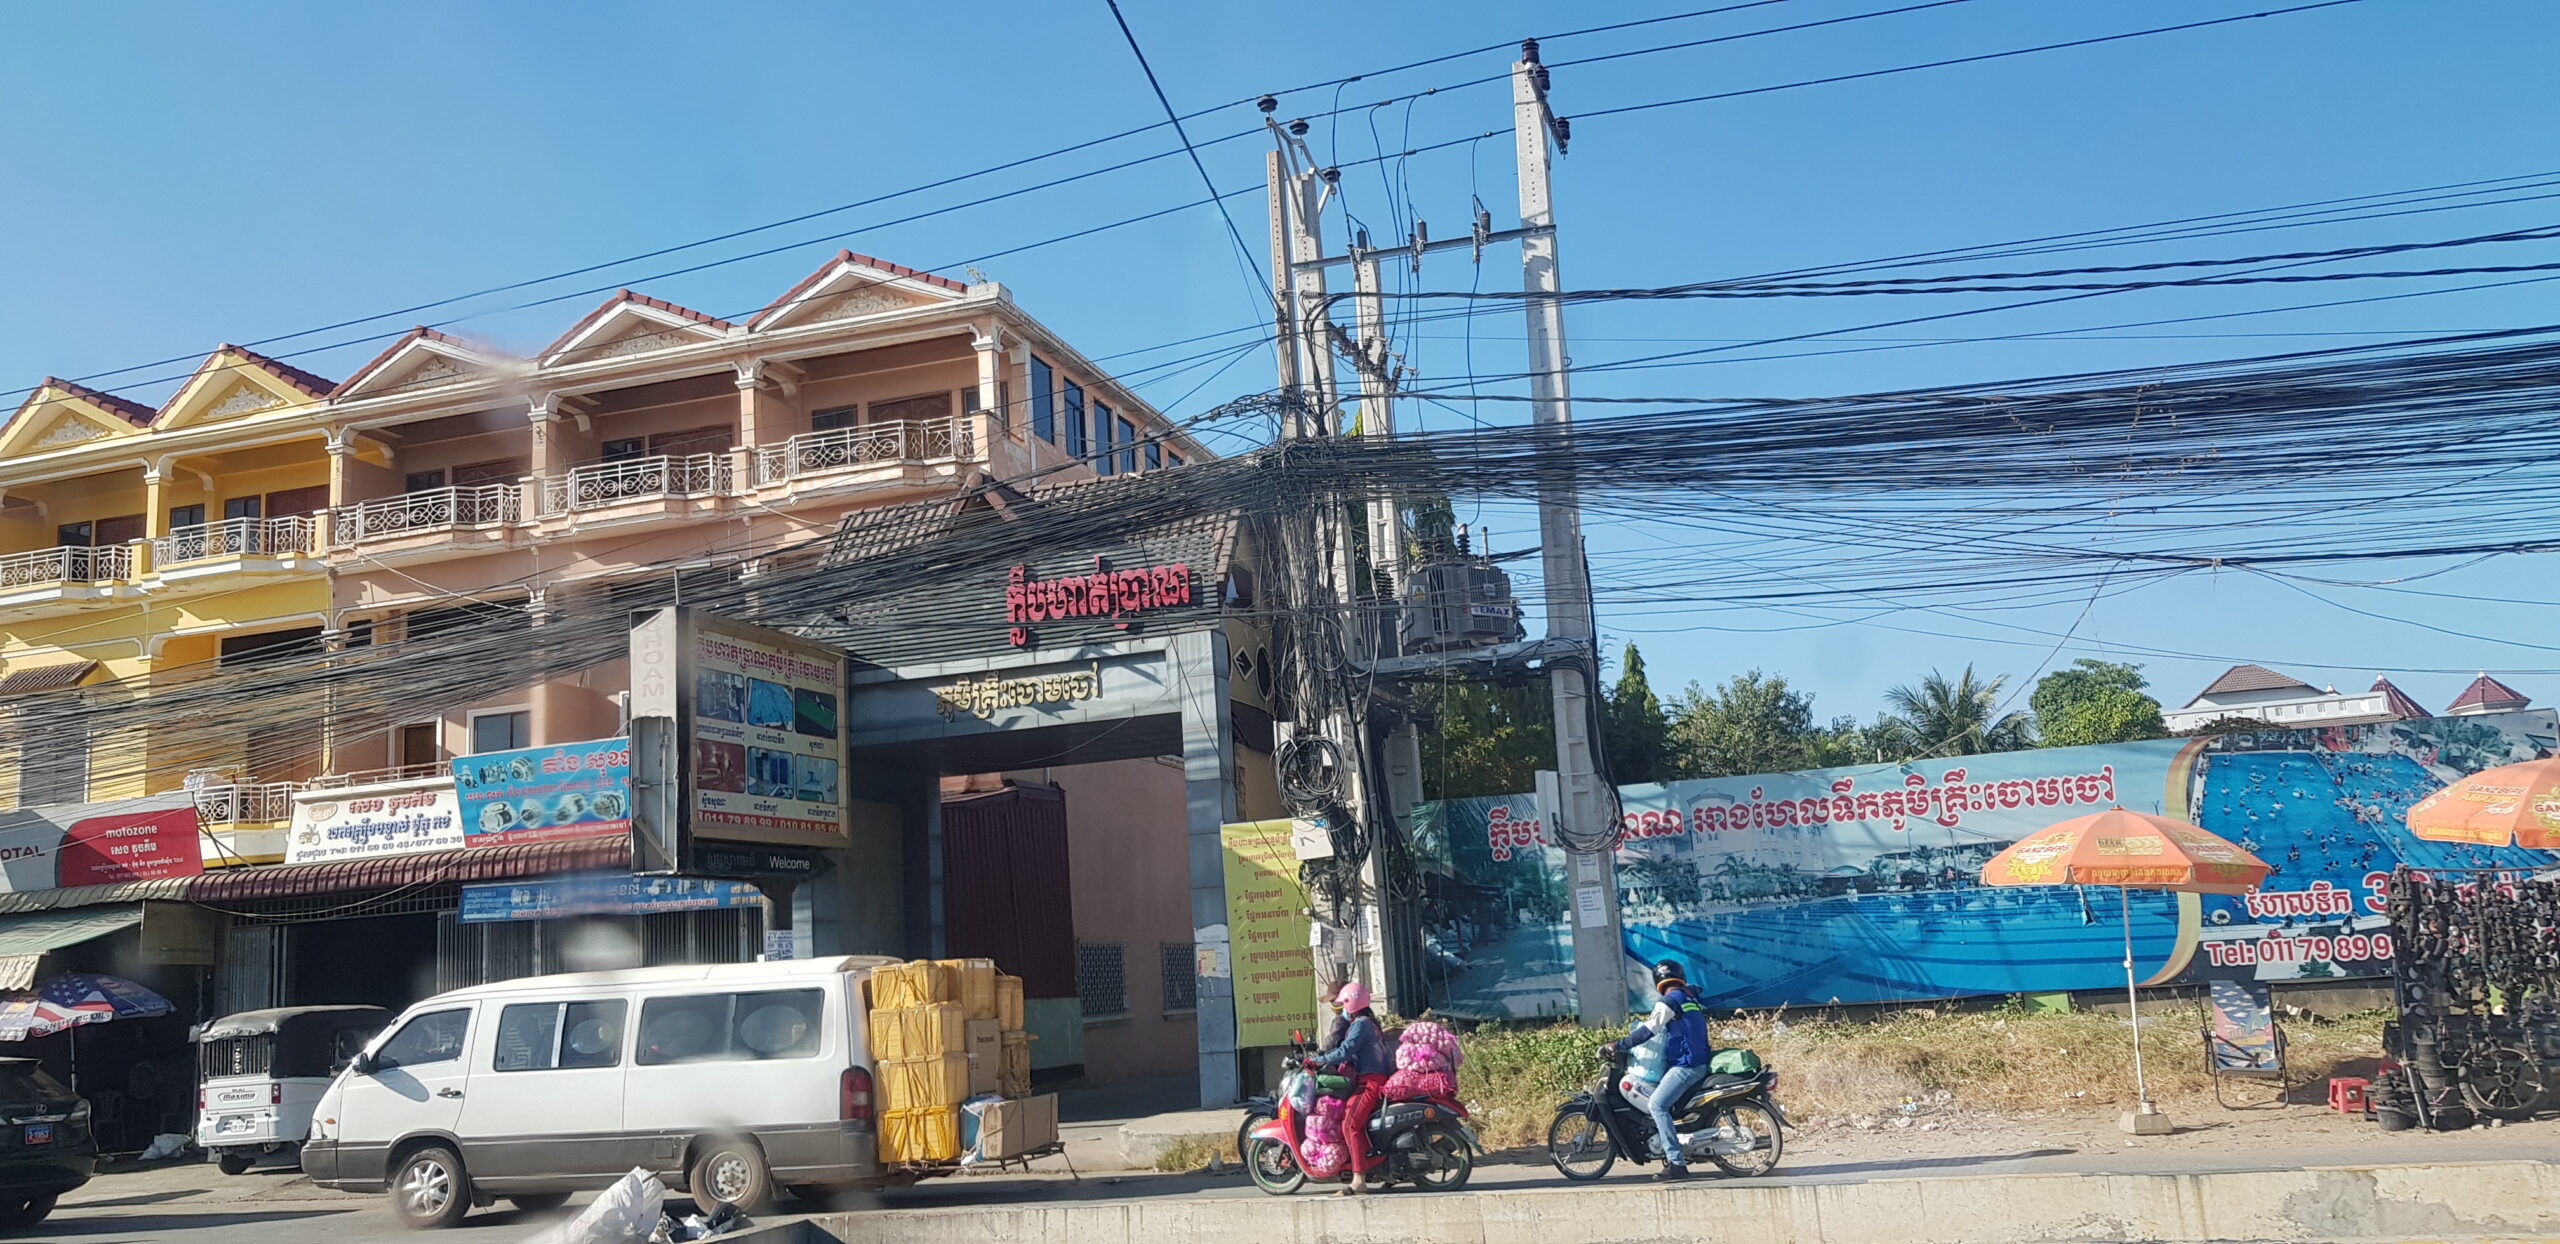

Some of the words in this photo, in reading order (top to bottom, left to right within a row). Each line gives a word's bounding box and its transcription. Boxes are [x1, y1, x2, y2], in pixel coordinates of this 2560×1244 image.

[106, 824, 158, 839] motozone
[769, 856, 811, 870] Welcome
[2245, 880, 2352, 918] ហែលទឹក
[2206, 940, 2255, 966] Tel:
[2257, 938, 2293, 964] 011
[2295, 936, 2332, 961] 79
[2335, 935, 2370, 960] 89
